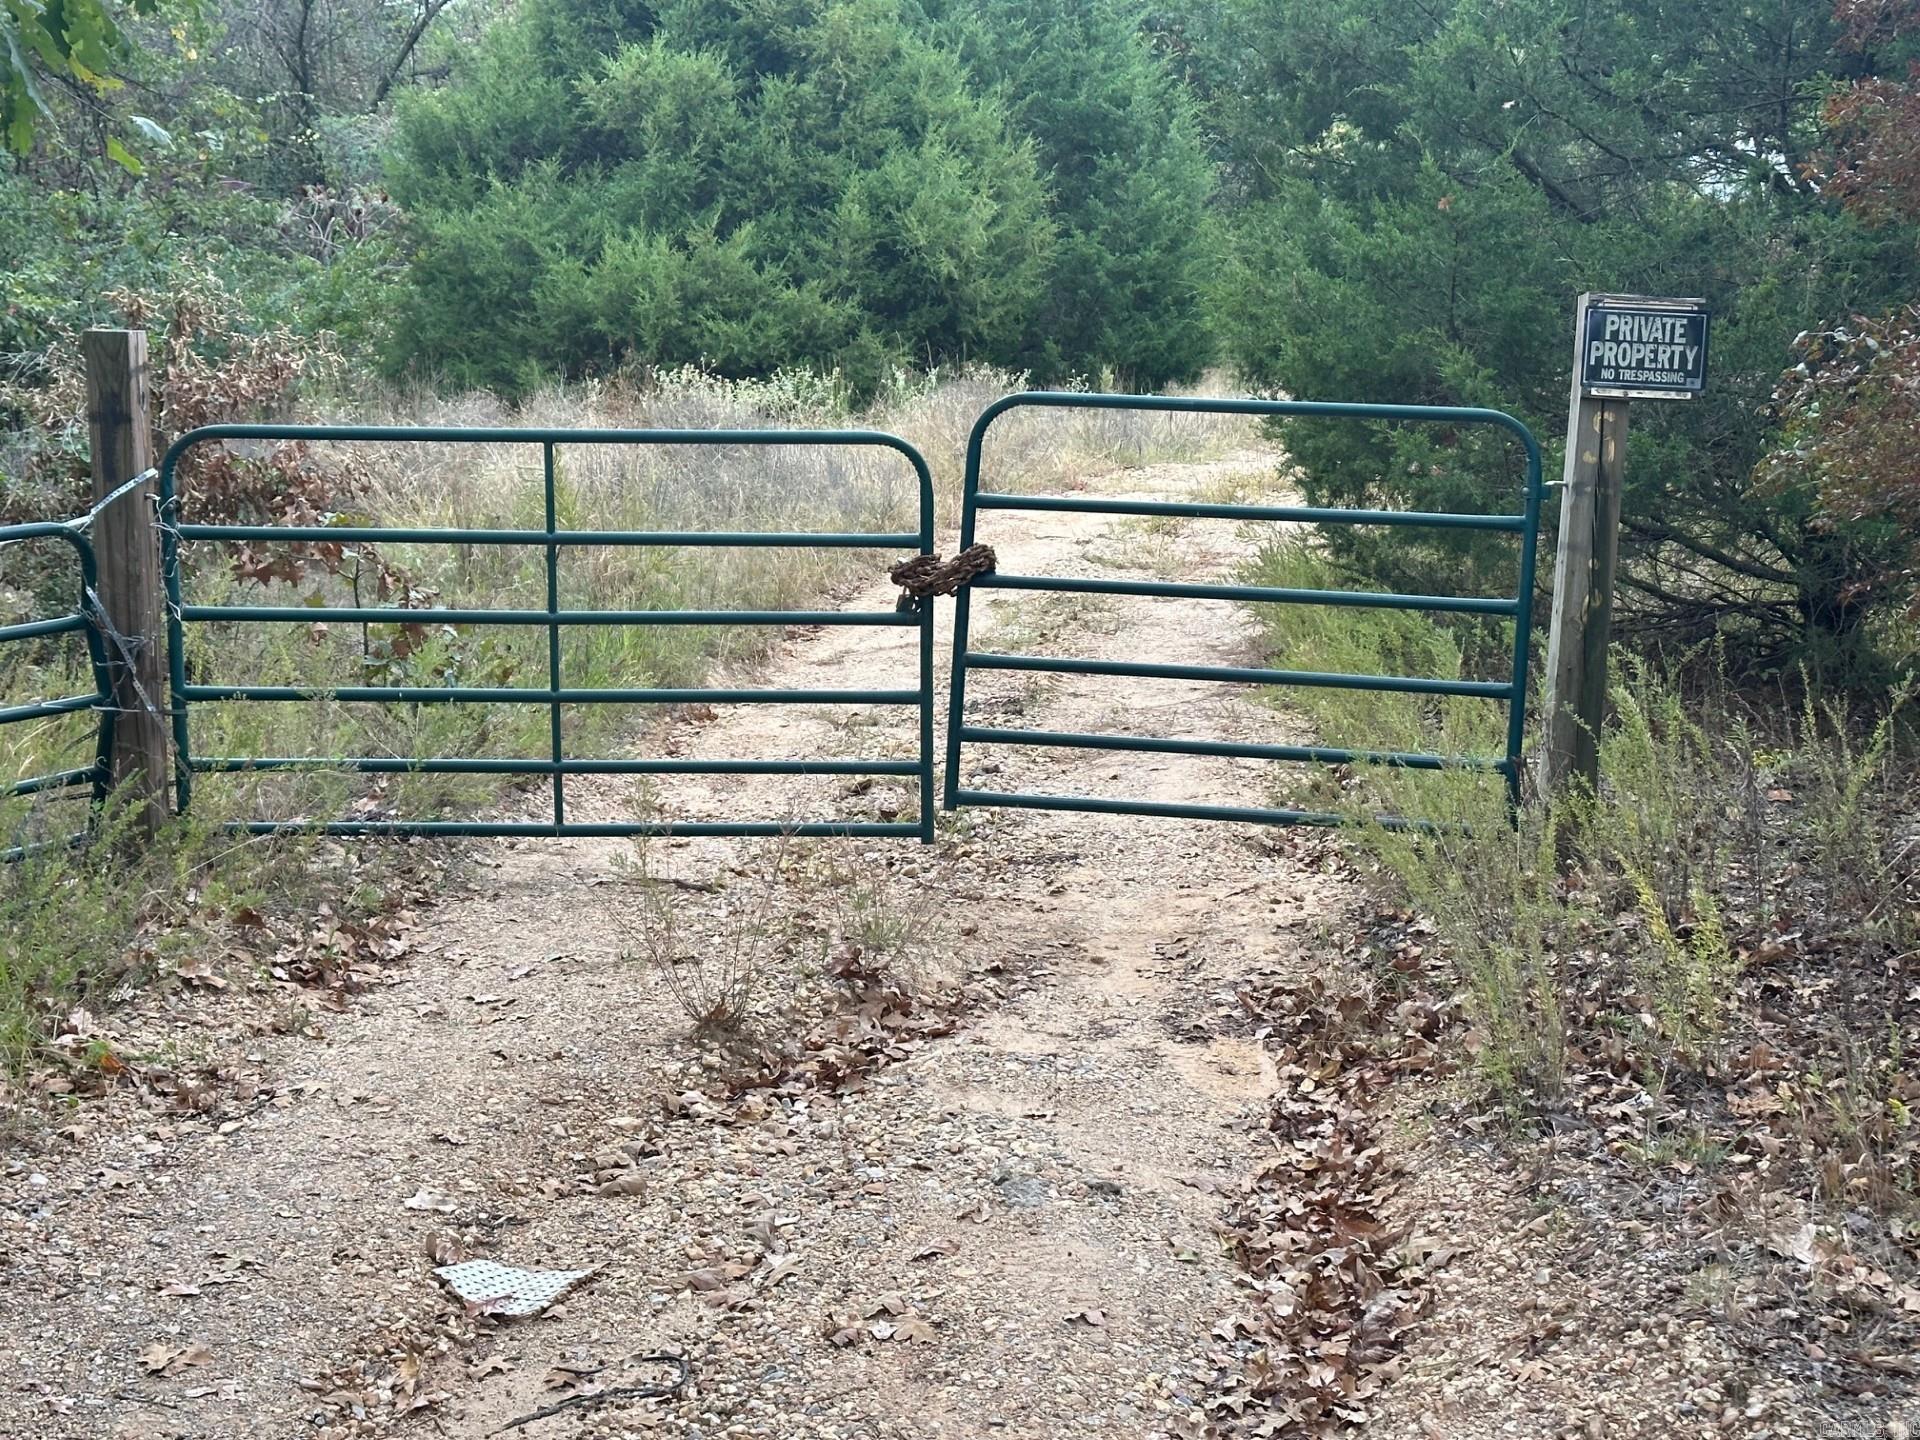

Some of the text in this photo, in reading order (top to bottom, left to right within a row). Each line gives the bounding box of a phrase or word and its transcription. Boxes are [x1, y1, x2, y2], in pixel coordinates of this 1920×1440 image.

[1605, 314, 1688, 344] PRIVATE
[1589, 341, 1699, 371] PROPERTY
[1601, 368, 1685, 383] NO TRESPASSING
